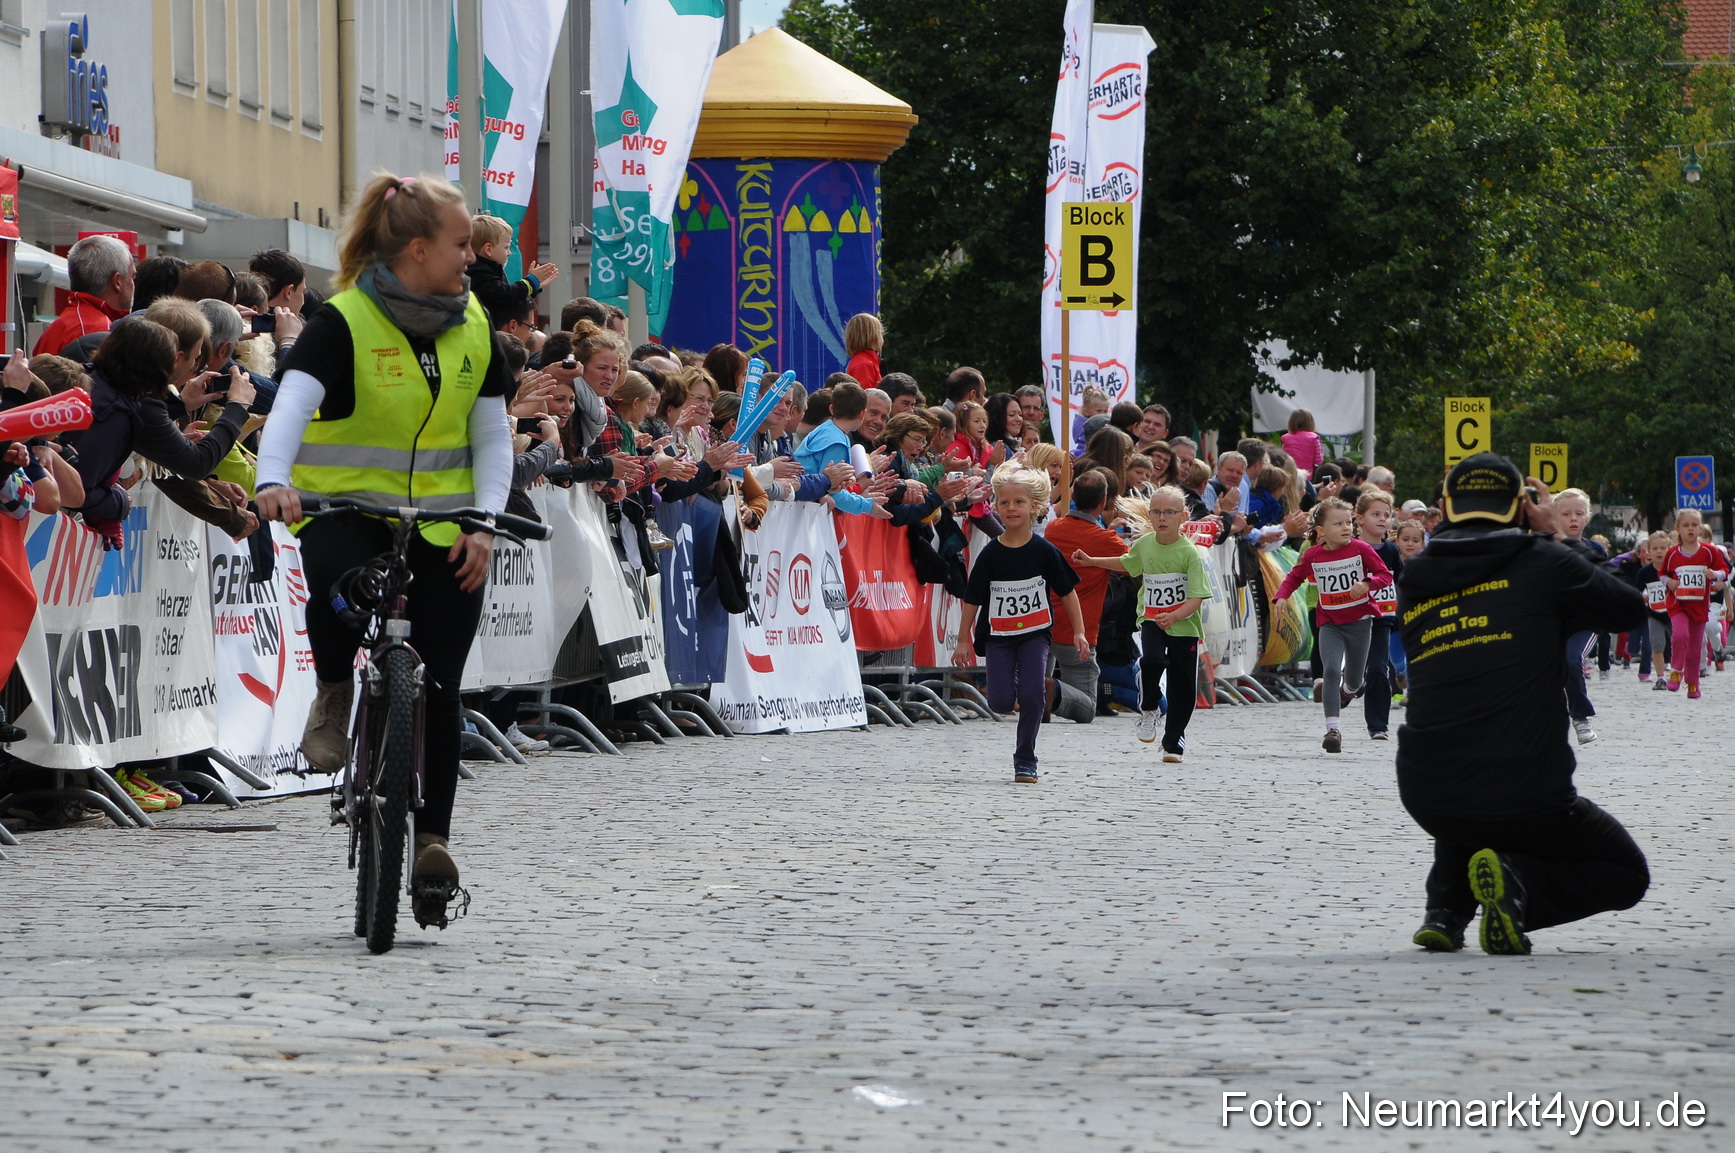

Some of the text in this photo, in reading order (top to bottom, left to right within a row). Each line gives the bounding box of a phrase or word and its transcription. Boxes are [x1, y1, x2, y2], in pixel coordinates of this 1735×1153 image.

[1070, 206, 1125, 226] Block
[1080, 234, 1116, 287] B
[1450, 400, 1486, 413] Block
[1456, 417, 1479, 450] C
[1534, 445, 1564, 456] Block
[1540, 460, 1558, 487] D
[1680, 494, 1712, 507] TAXI
[1328, 563, 1355, 572] Neumarkt
[793, 569, 811, 600] KIA
[1008, 584, 1037, 593] Neumarkt
[1319, 570, 1359, 593] 7208
[996, 590, 1042, 617] 7334
[1147, 584, 1186, 606] 7235
[1403, 592, 1459, 625] Skifahren
[1439, 605, 1459, 618] an
[1421, 615, 1488, 644] einem Tag
